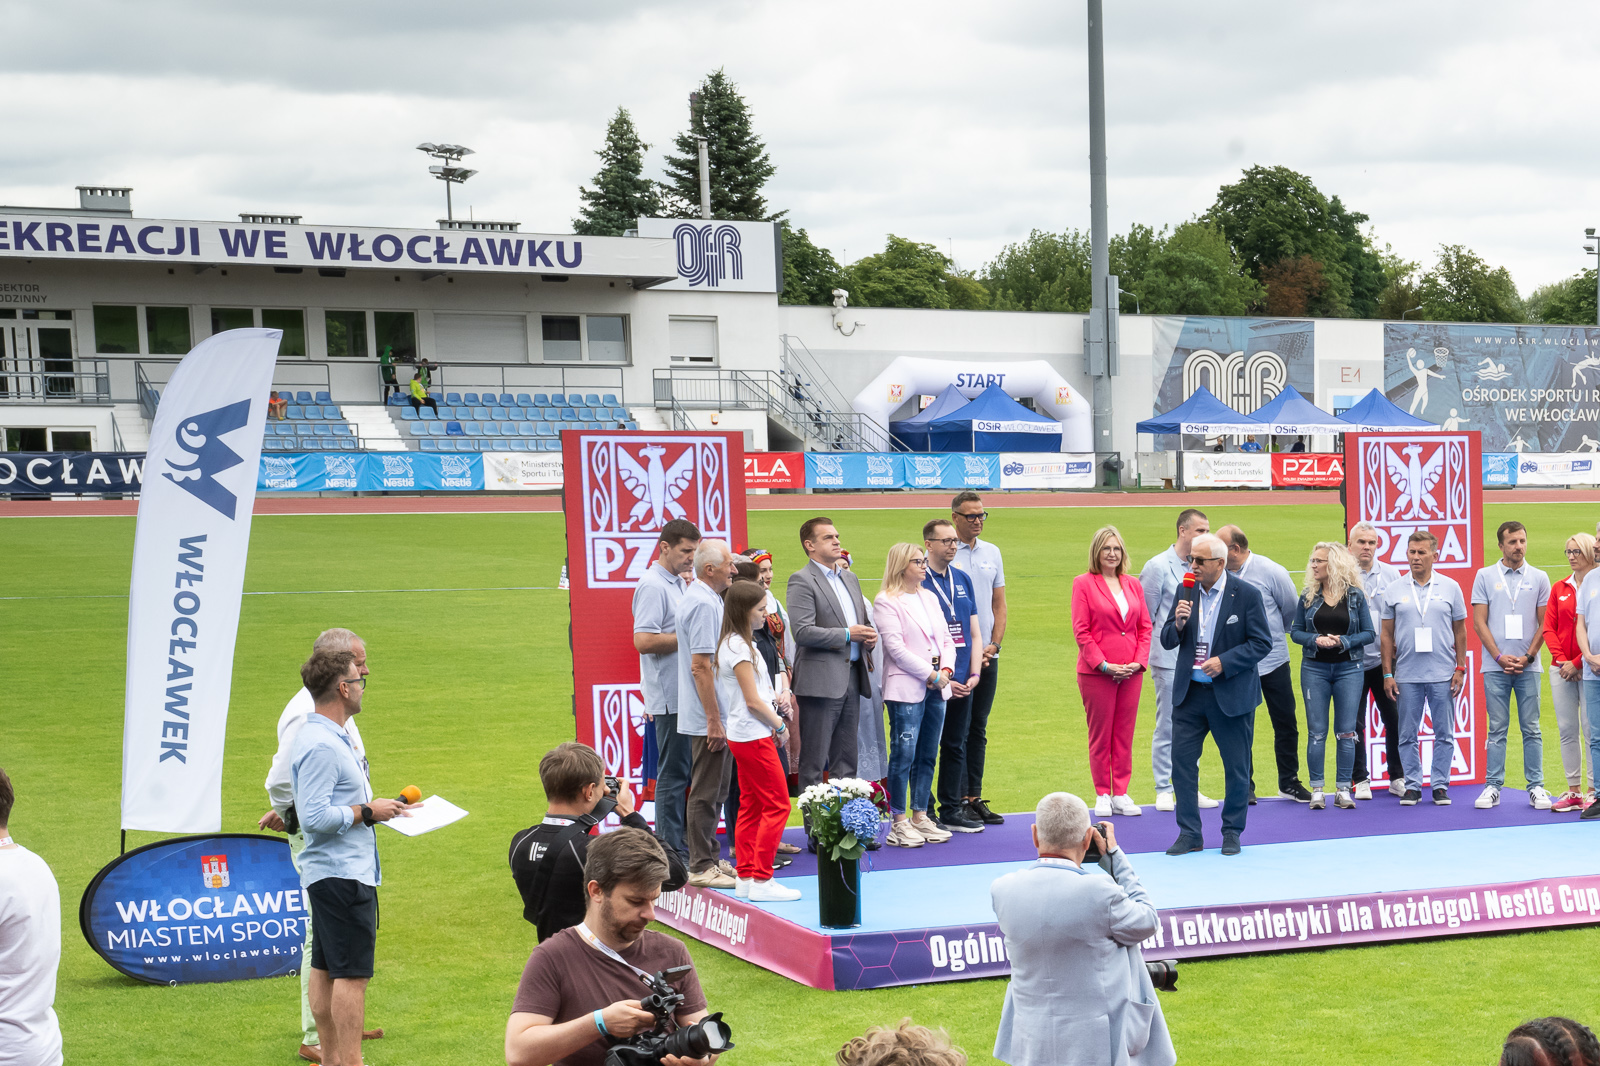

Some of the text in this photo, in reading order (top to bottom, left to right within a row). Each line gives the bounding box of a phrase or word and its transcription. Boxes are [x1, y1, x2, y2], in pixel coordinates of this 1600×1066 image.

[219, 228, 288, 259] WE
[305, 231, 583, 268] WŁOCŁAWKU
[956, 373, 1006, 388] START
[1341, 366, 1361, 382] E1
[1462, 384, 1527, 403] OŚRODEK
[1530, 389, 1582, 403] SPORTU
[1505, 408, 1526, 421] WE
[977, 421, 1001, 431] OSiR
[1186, 425, 1209, 434] OSiR
[1274, 425, 1298, 434] OSiR
[744, 458, 791, 477] ZLA
[1282, 459, 1344, 475] PZLA
[159, 534, 208, 764] WŁOCŁAWEK
[691, 893, 749, 946] dla każdego!
[1169, 903, 1333, 946] Lekkoatletyki
[1337, 901, 1374, 932] dla
[1378, 891, 1479, 928] każdego!
[1484, 882, 1555, 920] Nestlé
[1559, 883, 1600, 916] Cup
[107, 916, 309, 950] MIASTEM SPORT
